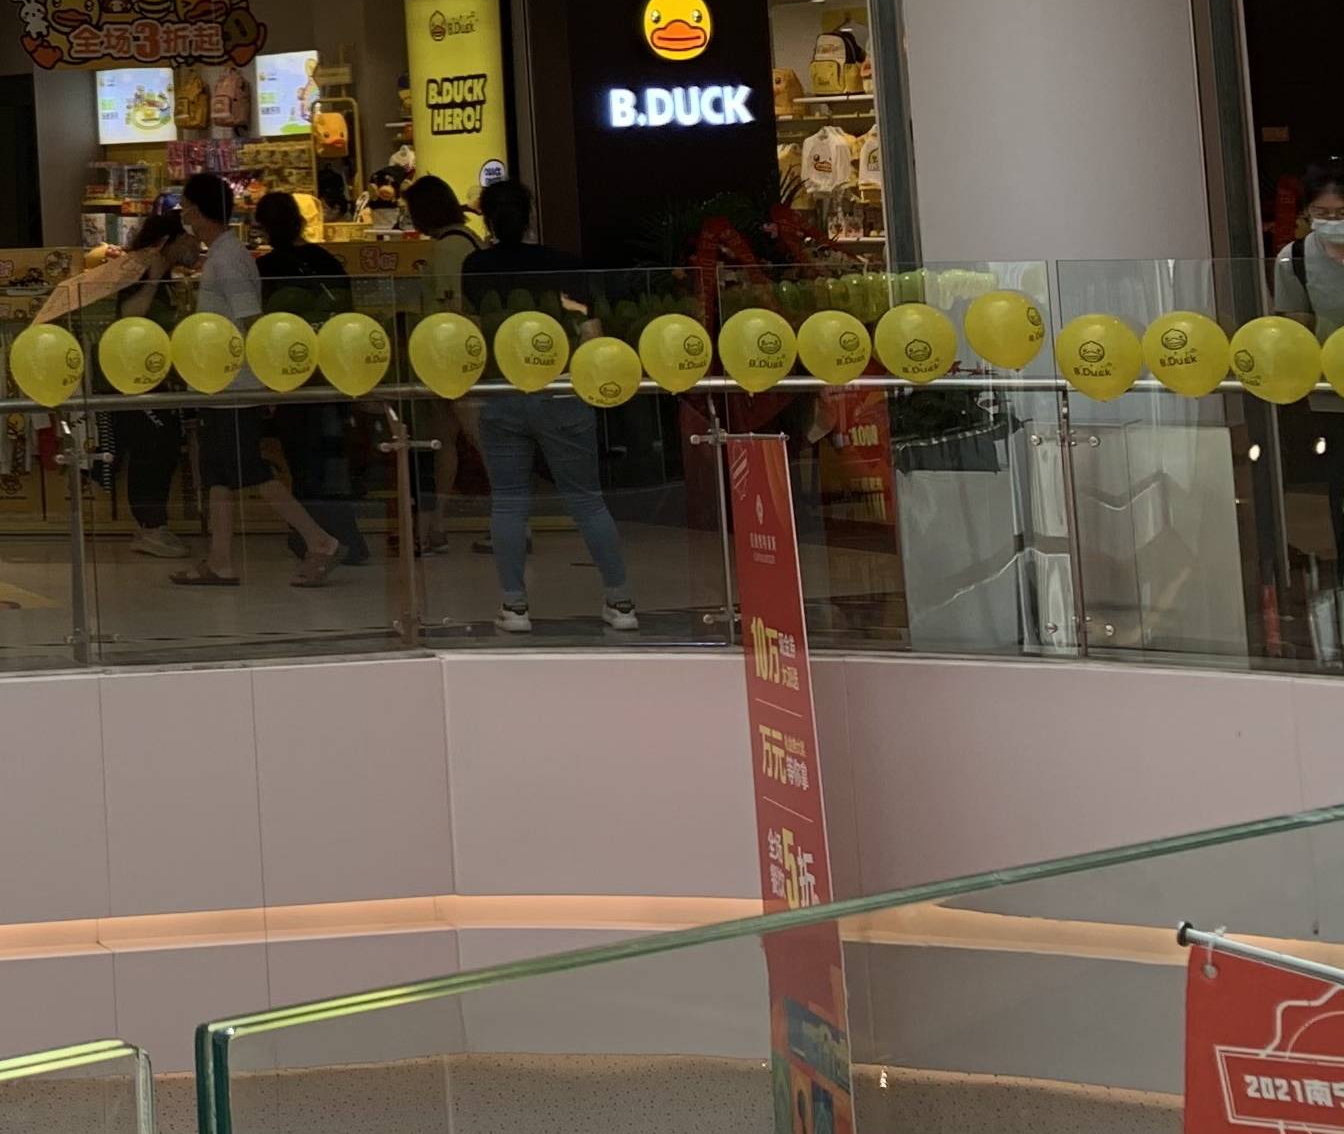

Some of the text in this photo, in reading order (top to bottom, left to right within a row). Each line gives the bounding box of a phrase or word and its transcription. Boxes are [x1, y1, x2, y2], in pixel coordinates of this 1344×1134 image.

[68, 19, 224, 63] 全场3折起
[427, 75, 487, 106] B.DUCK
[431, 105, 482, 134] HERO!
[609, 85, 754, 128] B.DUCK
[748, 357, 785, 370] B.Duck
[900, 361, 940, 375] B.Duck
[1073, 365, 1113, 379] B.Duck
[1159, 352, 1198, 367] B.Duck
[750, 616, 780, 684] 10万
[758, 724, 787, 785] 万元
